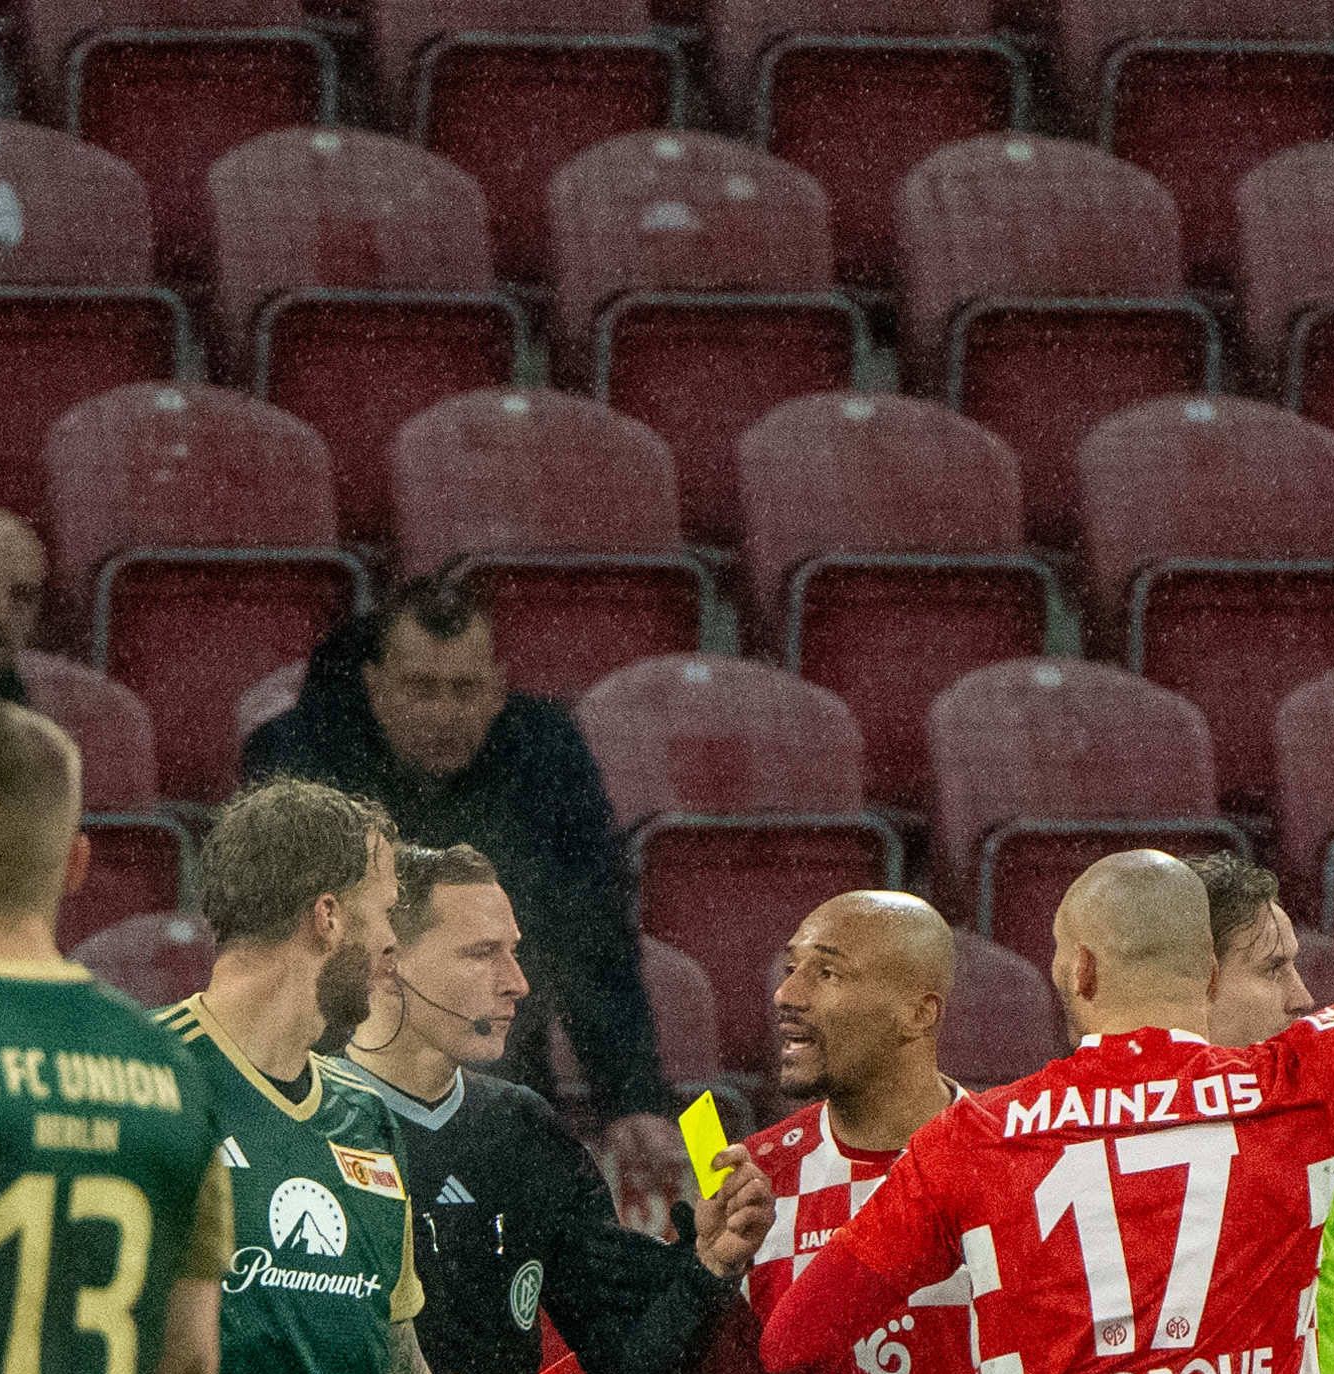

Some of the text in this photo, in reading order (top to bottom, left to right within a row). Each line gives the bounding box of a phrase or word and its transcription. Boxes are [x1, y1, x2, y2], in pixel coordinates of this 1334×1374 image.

[1, 1047, 51, 1098] FC
[56, 1050, 182, 1114] UNION
[1003, 1073, 1263, 1138] MAINZ 05
[799, 1228, 834, 1250] JAK
[1034, 1121, 1240, 1357] 17
[221, 1246, 381, 1299] Paramount+
